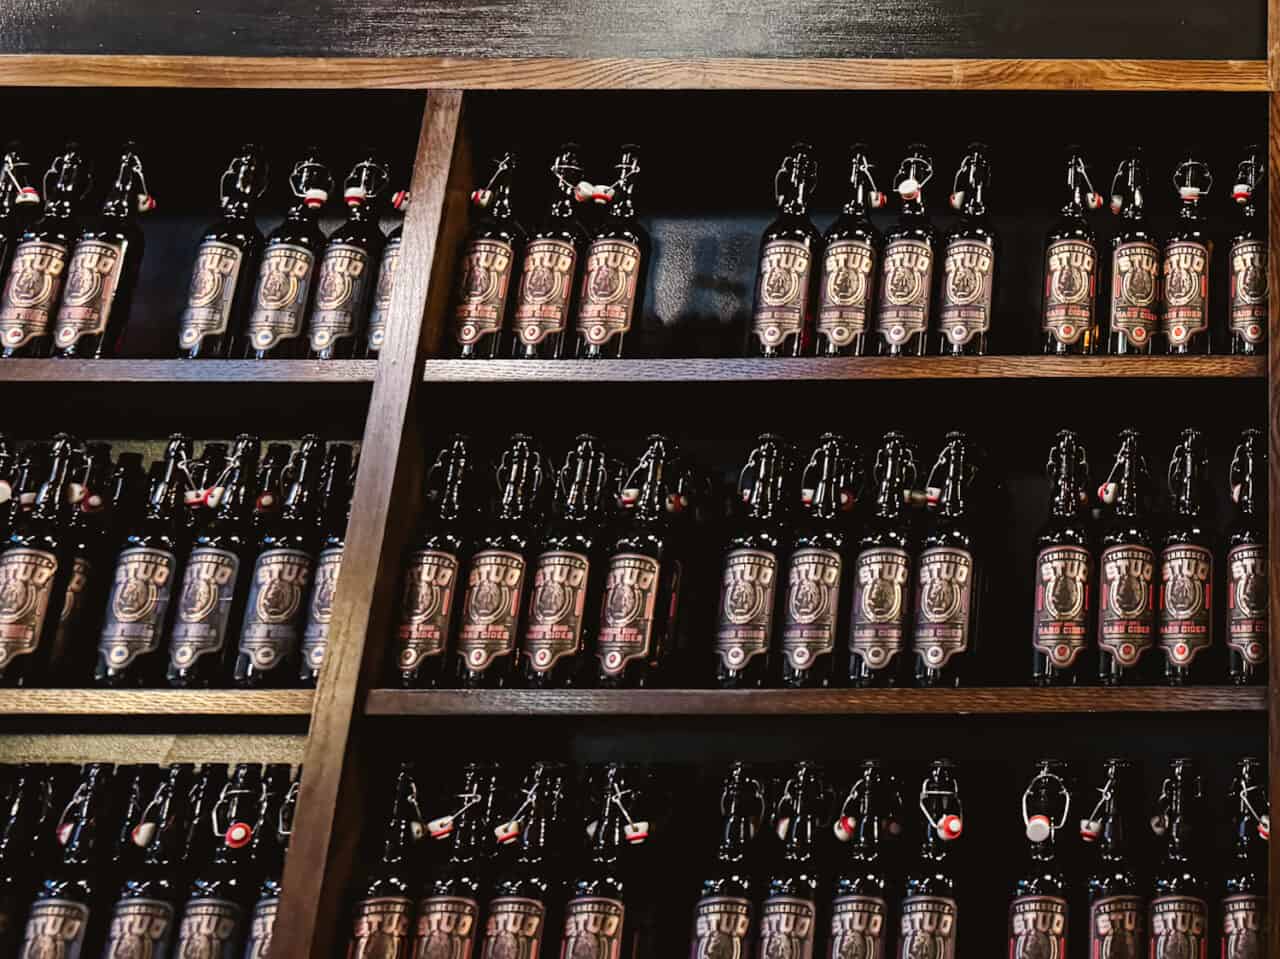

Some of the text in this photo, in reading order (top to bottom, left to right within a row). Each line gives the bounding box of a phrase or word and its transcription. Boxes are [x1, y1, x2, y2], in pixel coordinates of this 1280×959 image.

[761, 254, 807, 273] STUD
[826, 254, 872, 272] STUD
[884, 254, 929, 272] STUD
[945, 254, 991, 271] STUD
[1050, 252, 1093, 272] STUD
[725, 564, 773, 583] STUD
[790, 564, 837, 584] STUD
[860, 564, 908, 584] STUD
[920, 564, 967, 584] STUD
[1041, 560, 1088, 580] STUD
[1105, 560, 1152, 580] STUD
[1162, 560, 1209, 580] STUD
[697, 914, 748, 936] STUD
[832, 914, 882, 935] STUD
[901, 914, 952, 935] STUD
[1013, 912, 1064, 934] STUD
[1096, 912, 1136, 934] STU
[1153, 912, 1200, 934] STUD
